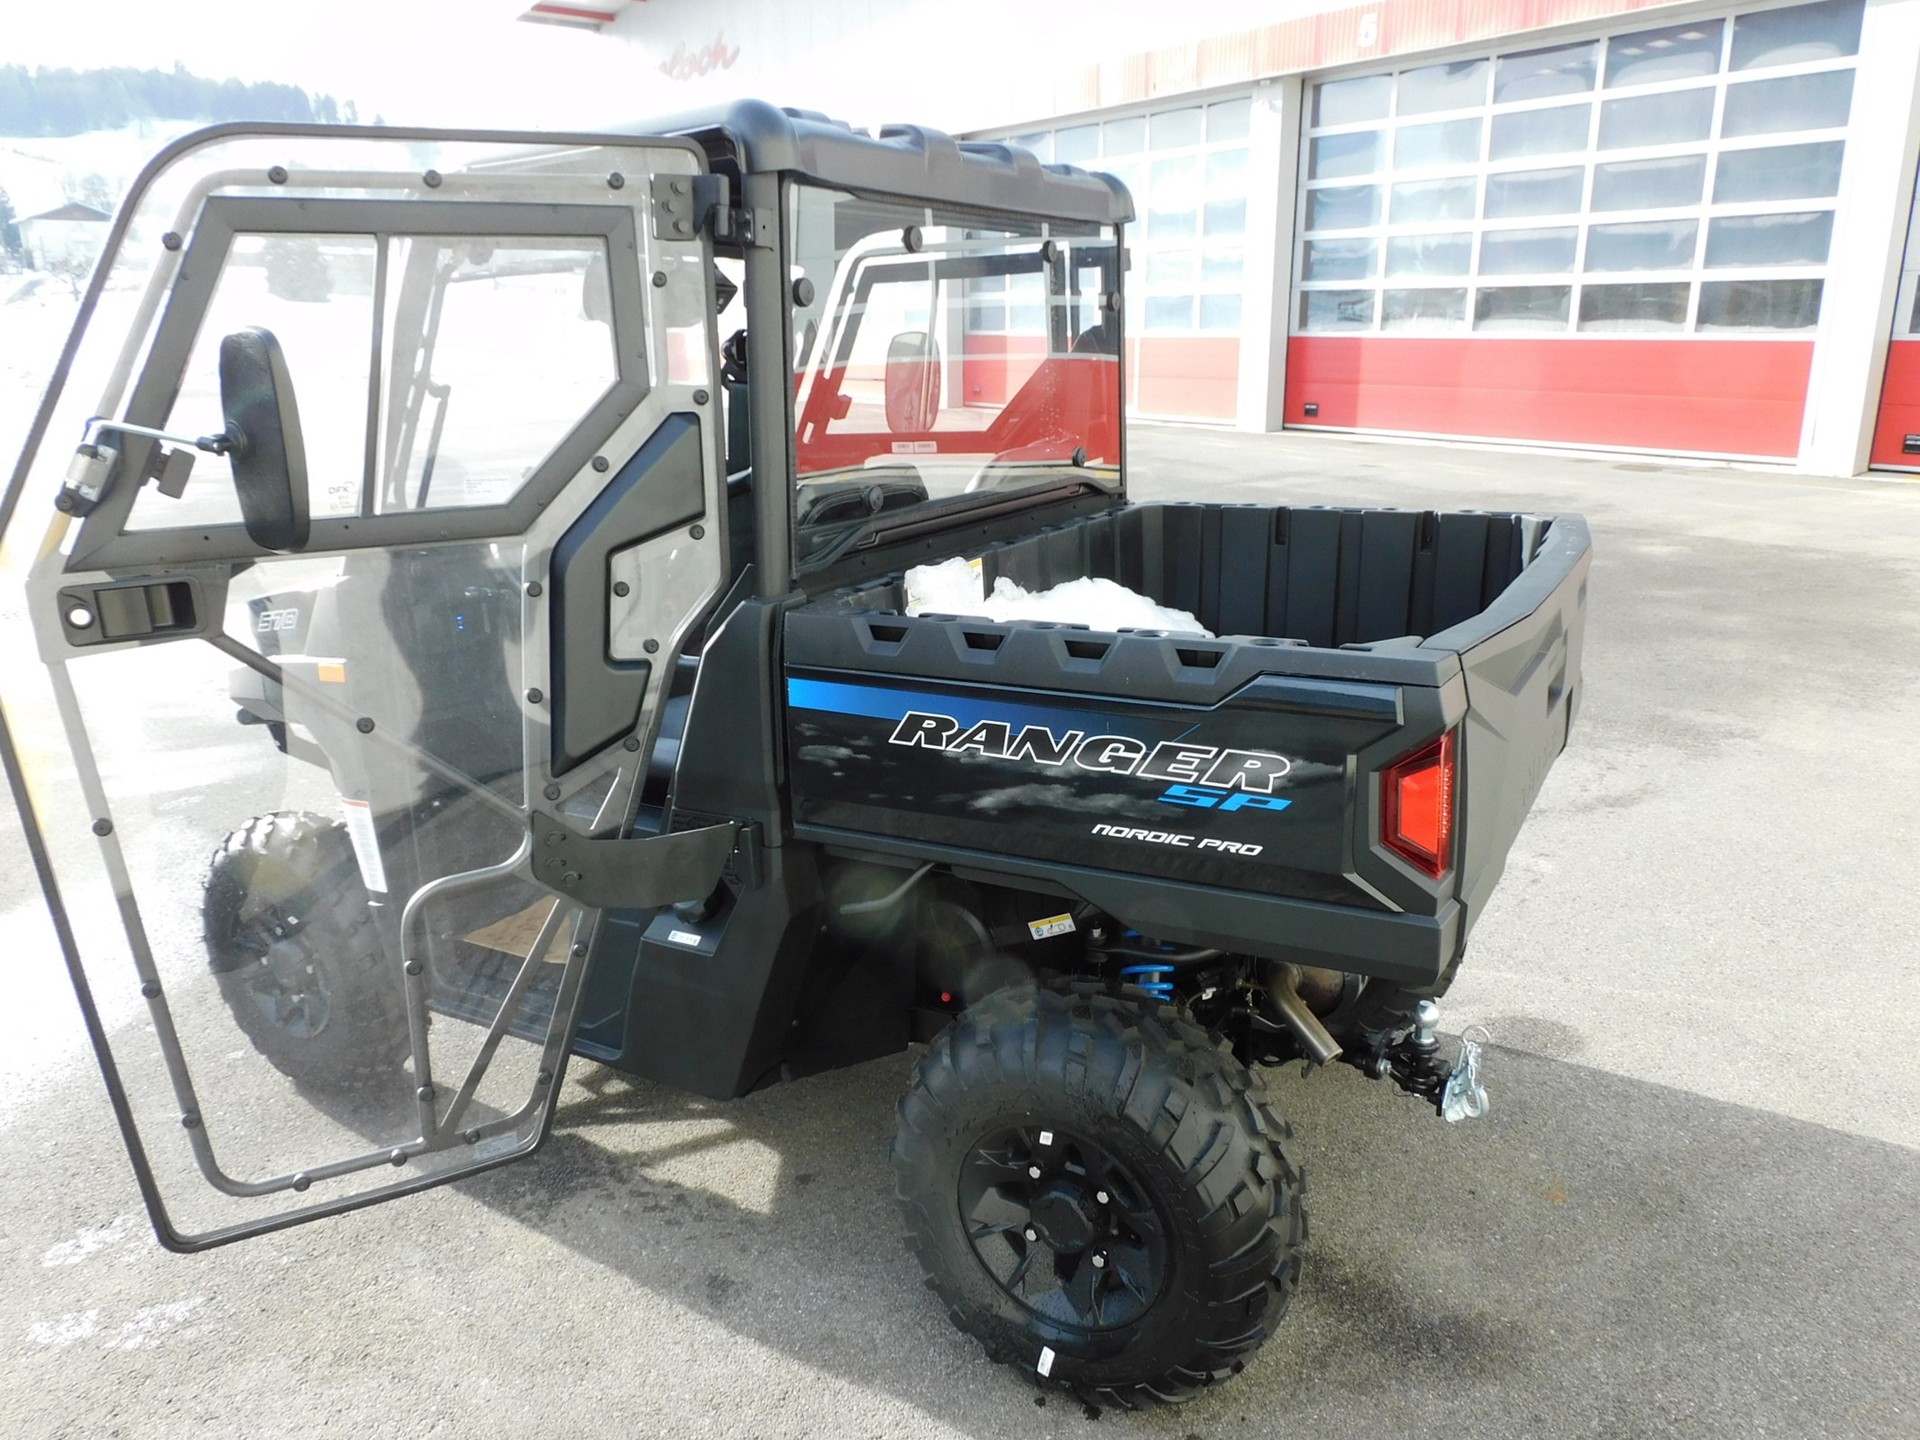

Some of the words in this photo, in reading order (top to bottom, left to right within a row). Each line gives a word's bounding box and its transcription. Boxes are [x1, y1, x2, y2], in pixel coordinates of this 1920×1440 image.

[888, 710, 1291, 794] RANGER
[1157, 784, 1293, 812] SP
[1091, 823, 1195, 847] NORDIC
[1197, 838, 1263, 856] PRO
